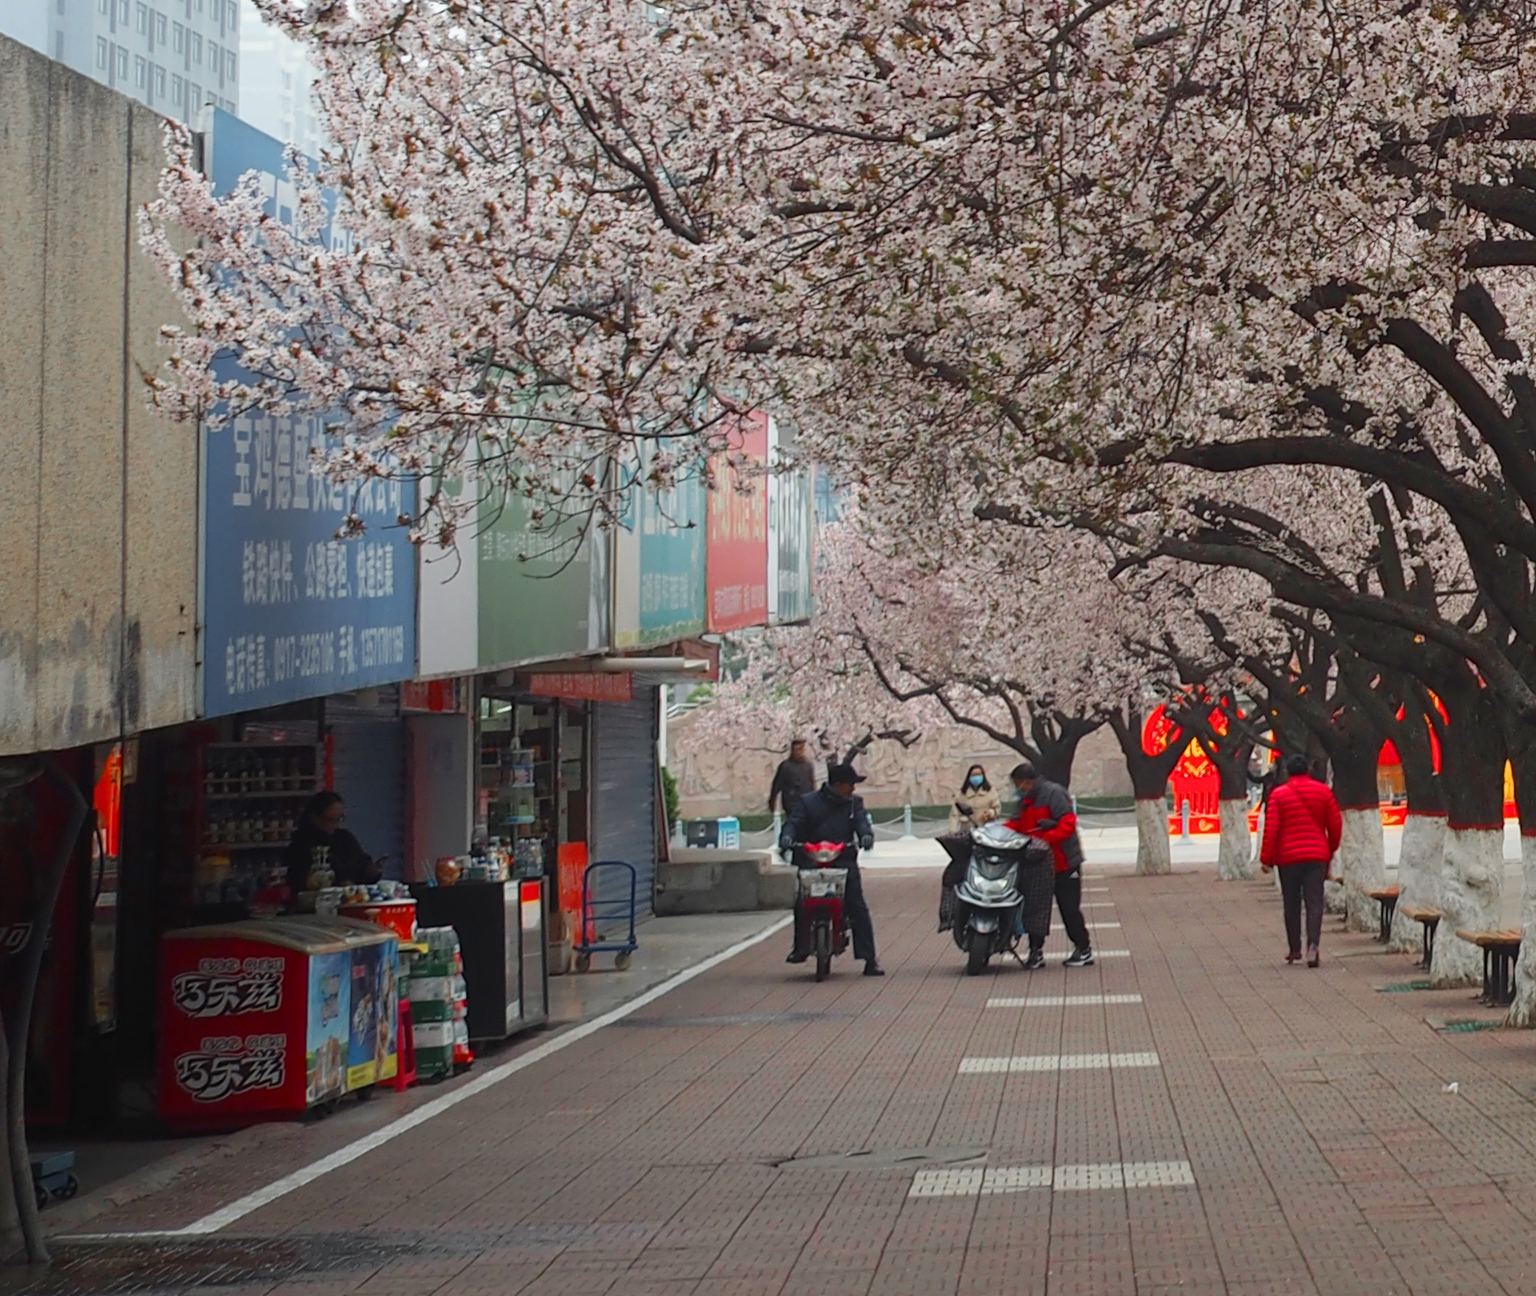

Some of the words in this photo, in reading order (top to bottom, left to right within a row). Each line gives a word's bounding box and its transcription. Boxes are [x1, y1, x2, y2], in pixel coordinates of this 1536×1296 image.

[173, 972, 283, 1018] 巧乐兹
[175, 1050, 285, 1102] 巧乐兹
